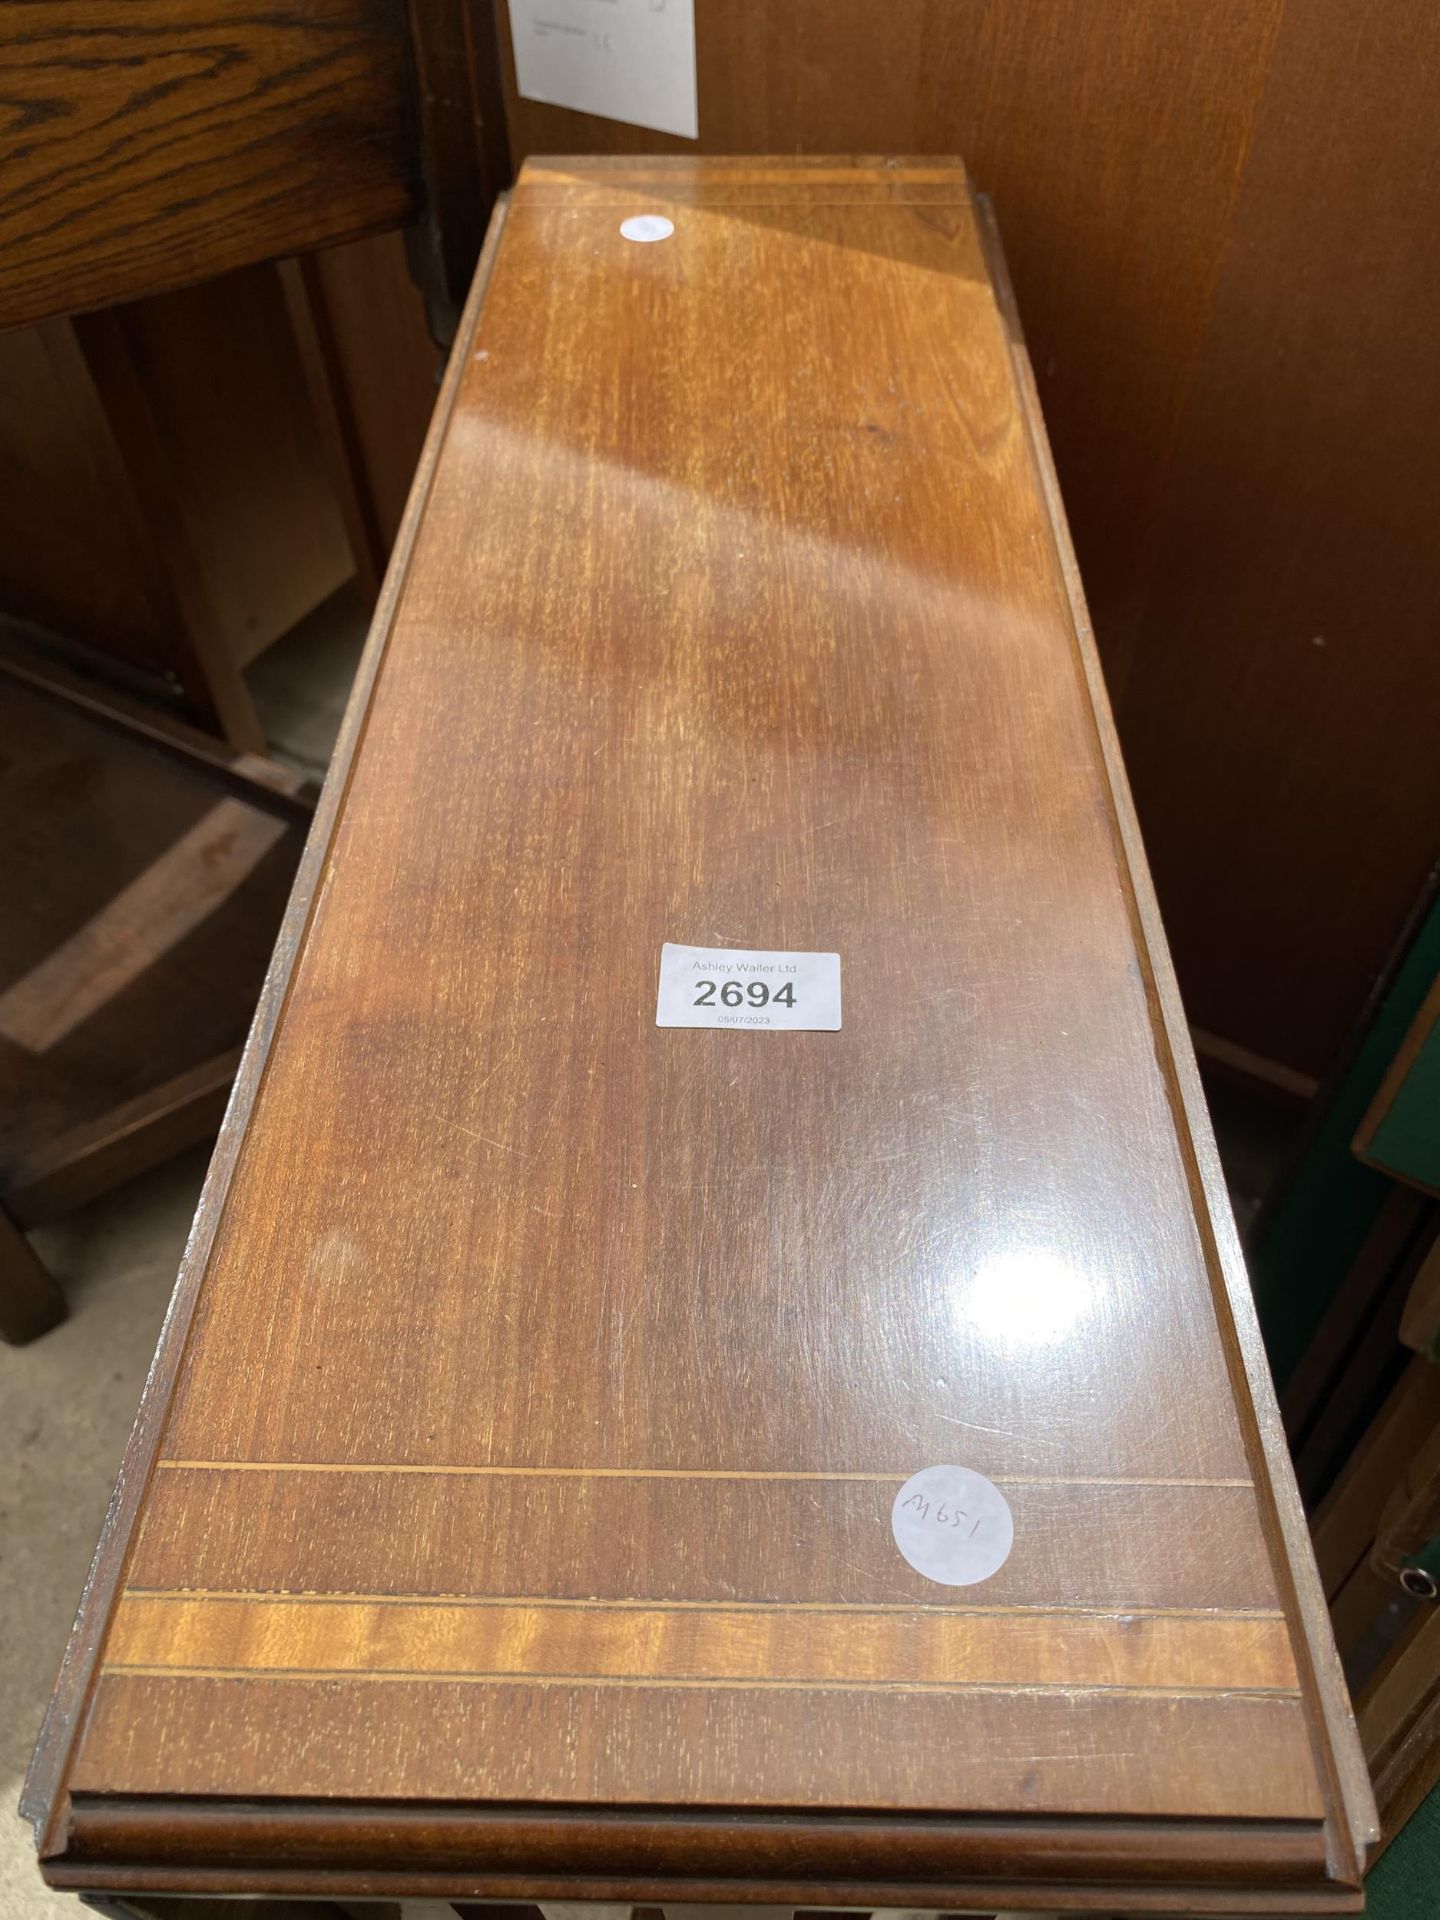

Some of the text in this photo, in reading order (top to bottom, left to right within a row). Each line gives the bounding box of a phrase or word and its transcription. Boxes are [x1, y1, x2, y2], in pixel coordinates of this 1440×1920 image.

[693, 961, 797, 973] Ashley Waller Ltd
[694, 980, 797, 1008] 2694
[717, 1016, 770, 1024] 05/07/2023
